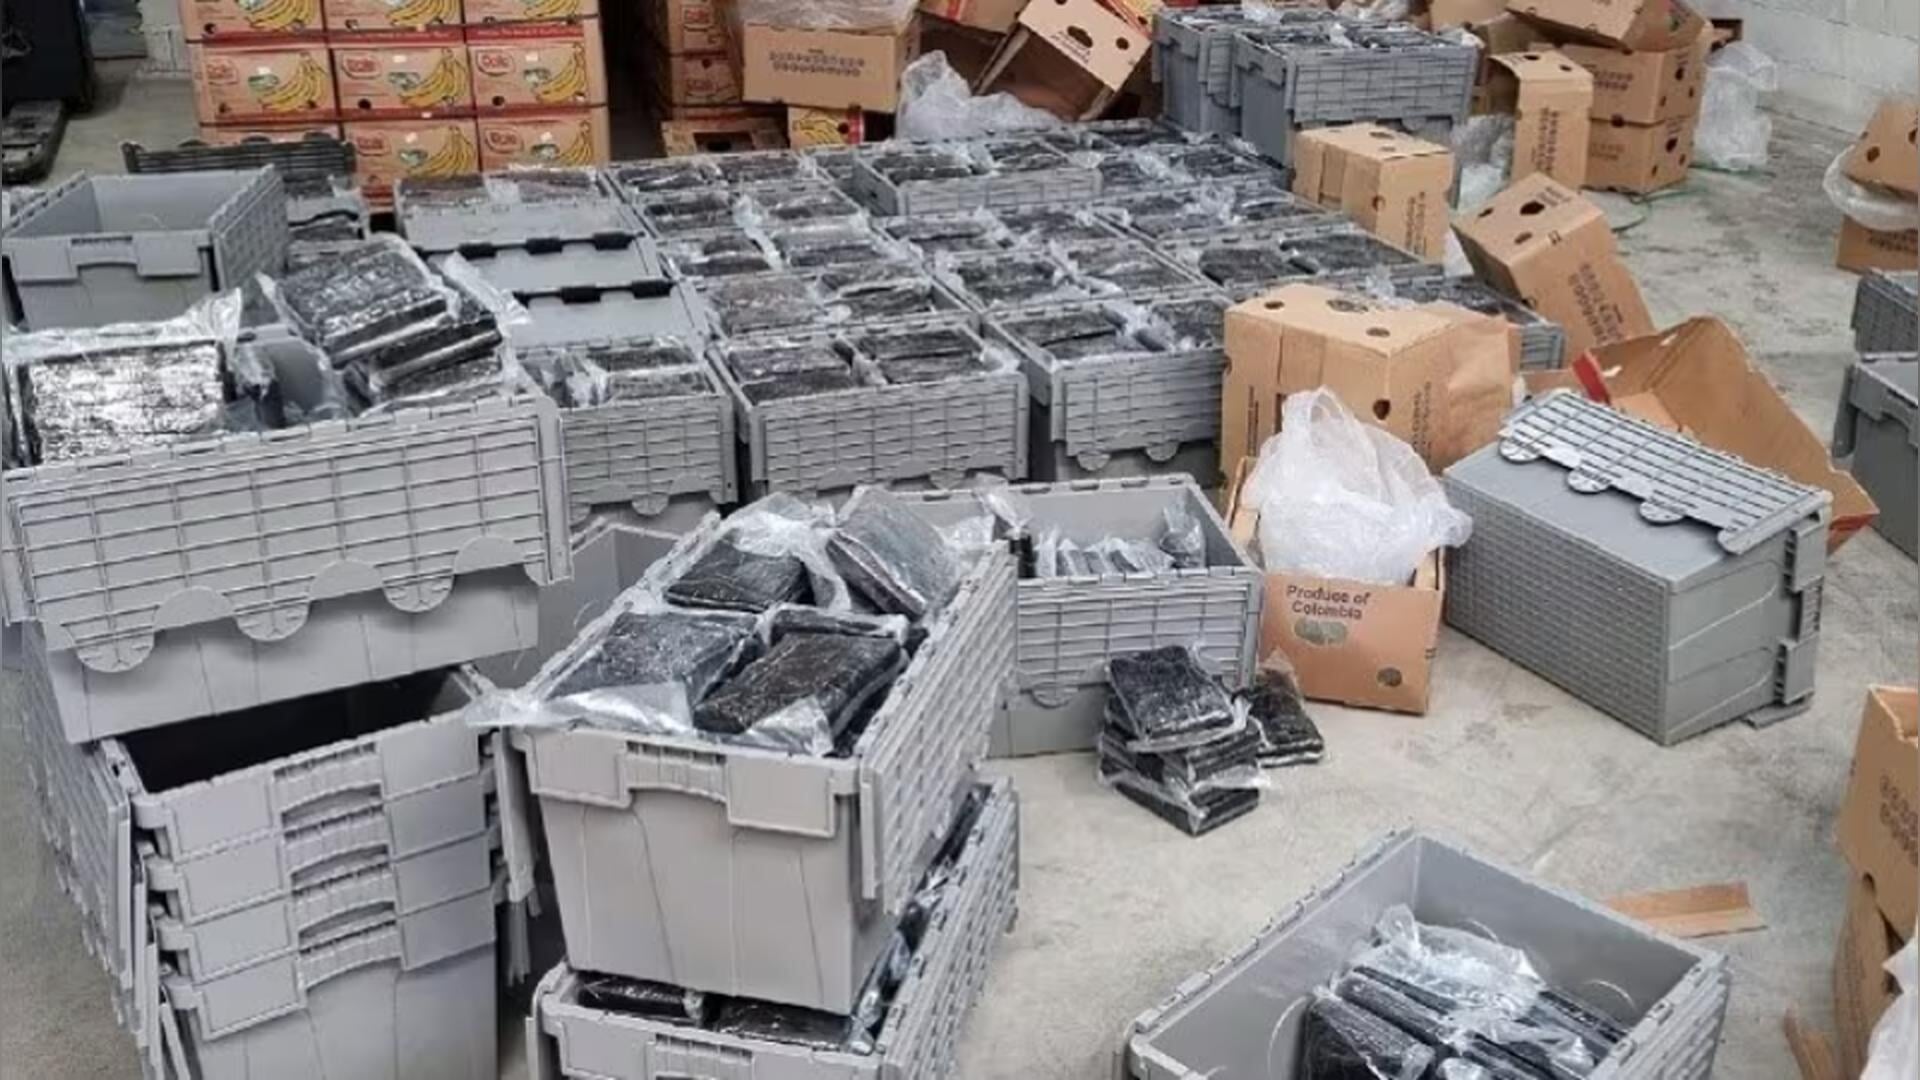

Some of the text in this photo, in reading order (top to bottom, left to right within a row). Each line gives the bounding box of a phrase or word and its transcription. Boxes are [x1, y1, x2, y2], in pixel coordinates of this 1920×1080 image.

[1287, 585, 1371, 605] Produce of
[1292, 600, 1362, 620] Colombia
